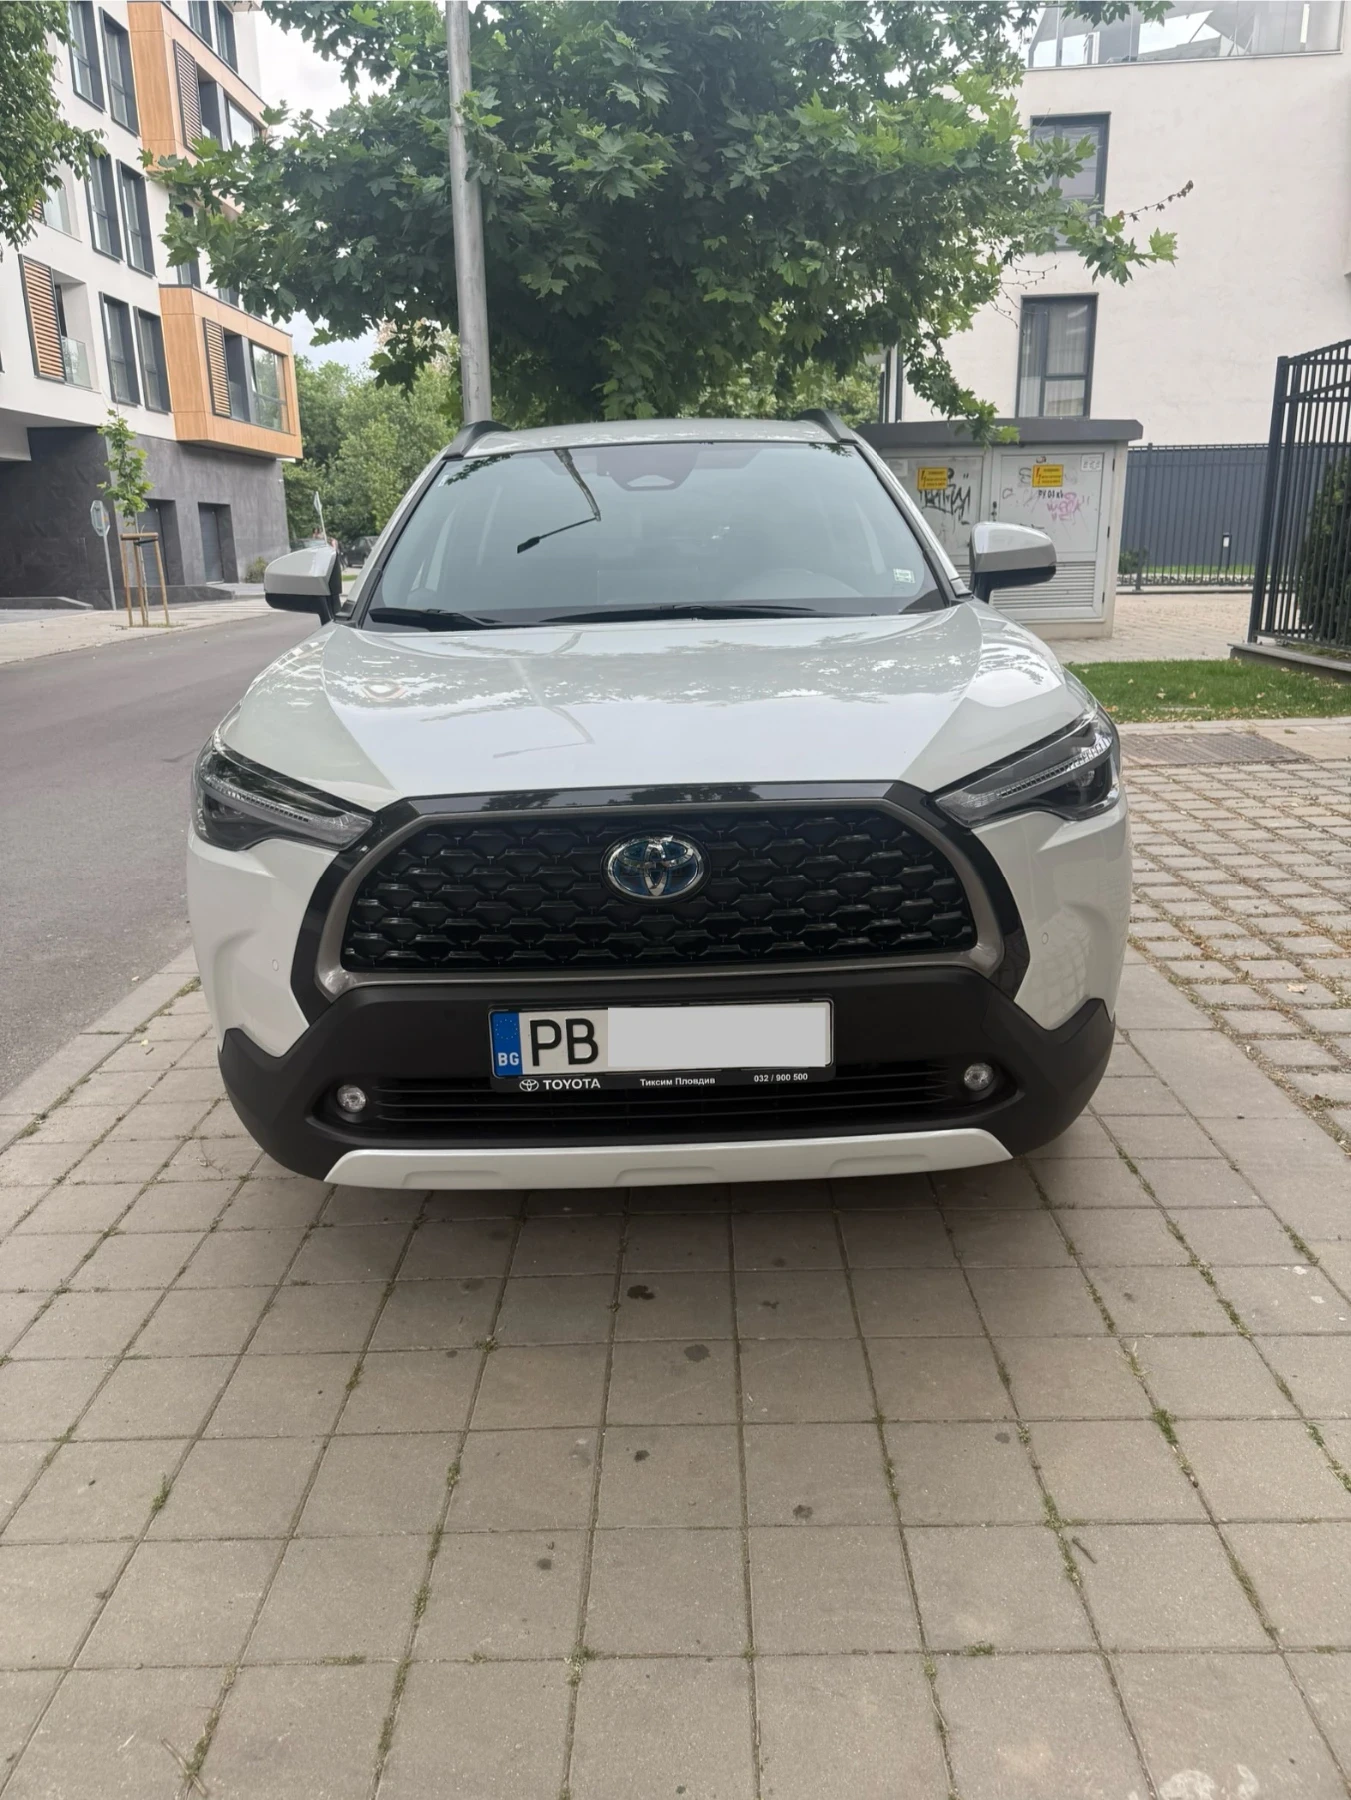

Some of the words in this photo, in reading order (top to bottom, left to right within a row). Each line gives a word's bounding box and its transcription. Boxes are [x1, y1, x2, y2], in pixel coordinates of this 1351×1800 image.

[497, 1052, 520, 1066] BG
[640, 1078, 673, 1087] Тиксим
[675, 1077, 716, 1086] Пловдив
[753, 1074, 769, 1083] 032
[776, 1073, 791, 1082] 900
[793, 1072, 808, 1081] 500
[542, 1078, 601, 1090] TOYOTA
